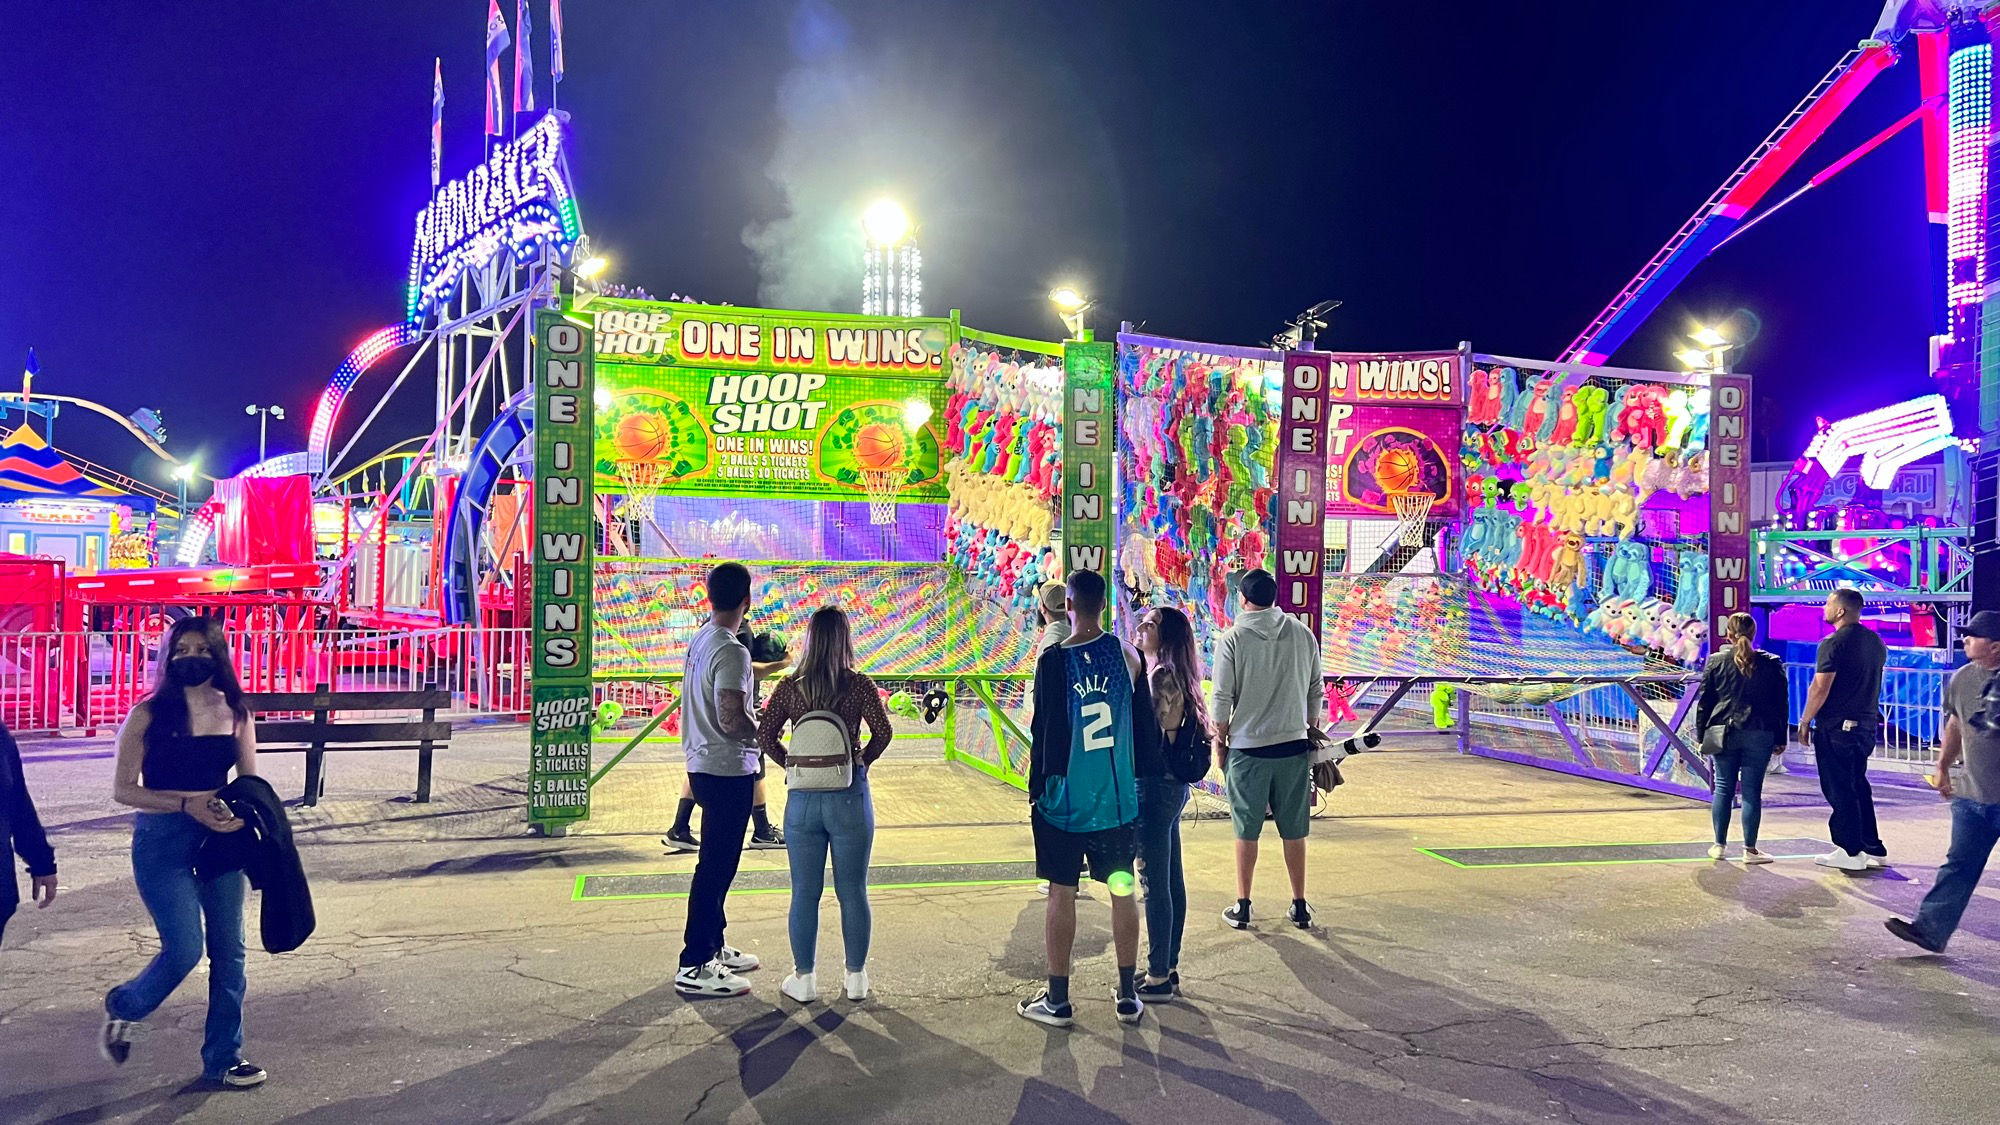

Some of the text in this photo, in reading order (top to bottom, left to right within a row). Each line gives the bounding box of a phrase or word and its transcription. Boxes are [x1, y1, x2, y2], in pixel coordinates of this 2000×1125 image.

[682, 319, 944, 366] ONE IN WINS!
[708, 373, 827, 405] HOOP
[1330, 360, 1453, 394] N WINS!
[712, 401, 828, 434] SHOT
[1291, 365, 1319, 452] ONE
[1718, 386, 1742, 467] ONE
[716, 436, 813, 455] ONE IN WINS!
[721, 454, 808, 468] 2 BALLS 5 TICKETS
[717, 467, 810, 480] 5 BALLS 10 TICKETS
[540, 325, 581, 667] ONE IN WINS
[1072, 462, 1100, 520] IN
[1287, 469, 1313, 525] IN
[1717, 482, 1740, 533] IN
[1073, 674, 1109, 699] BALL
[535, 697, 590, 717] HOOP
[536, 711, 590, 732] SHOT
[1081, 701, 1115, 752] 2
[534, 743, 589, 757] 2 BALLS
[535, 758, 587, 772] 5 TICKETS
[533, 778, 588, 793] 5 BALLS
[533, 793, 588, 808] 10 TICKETS
